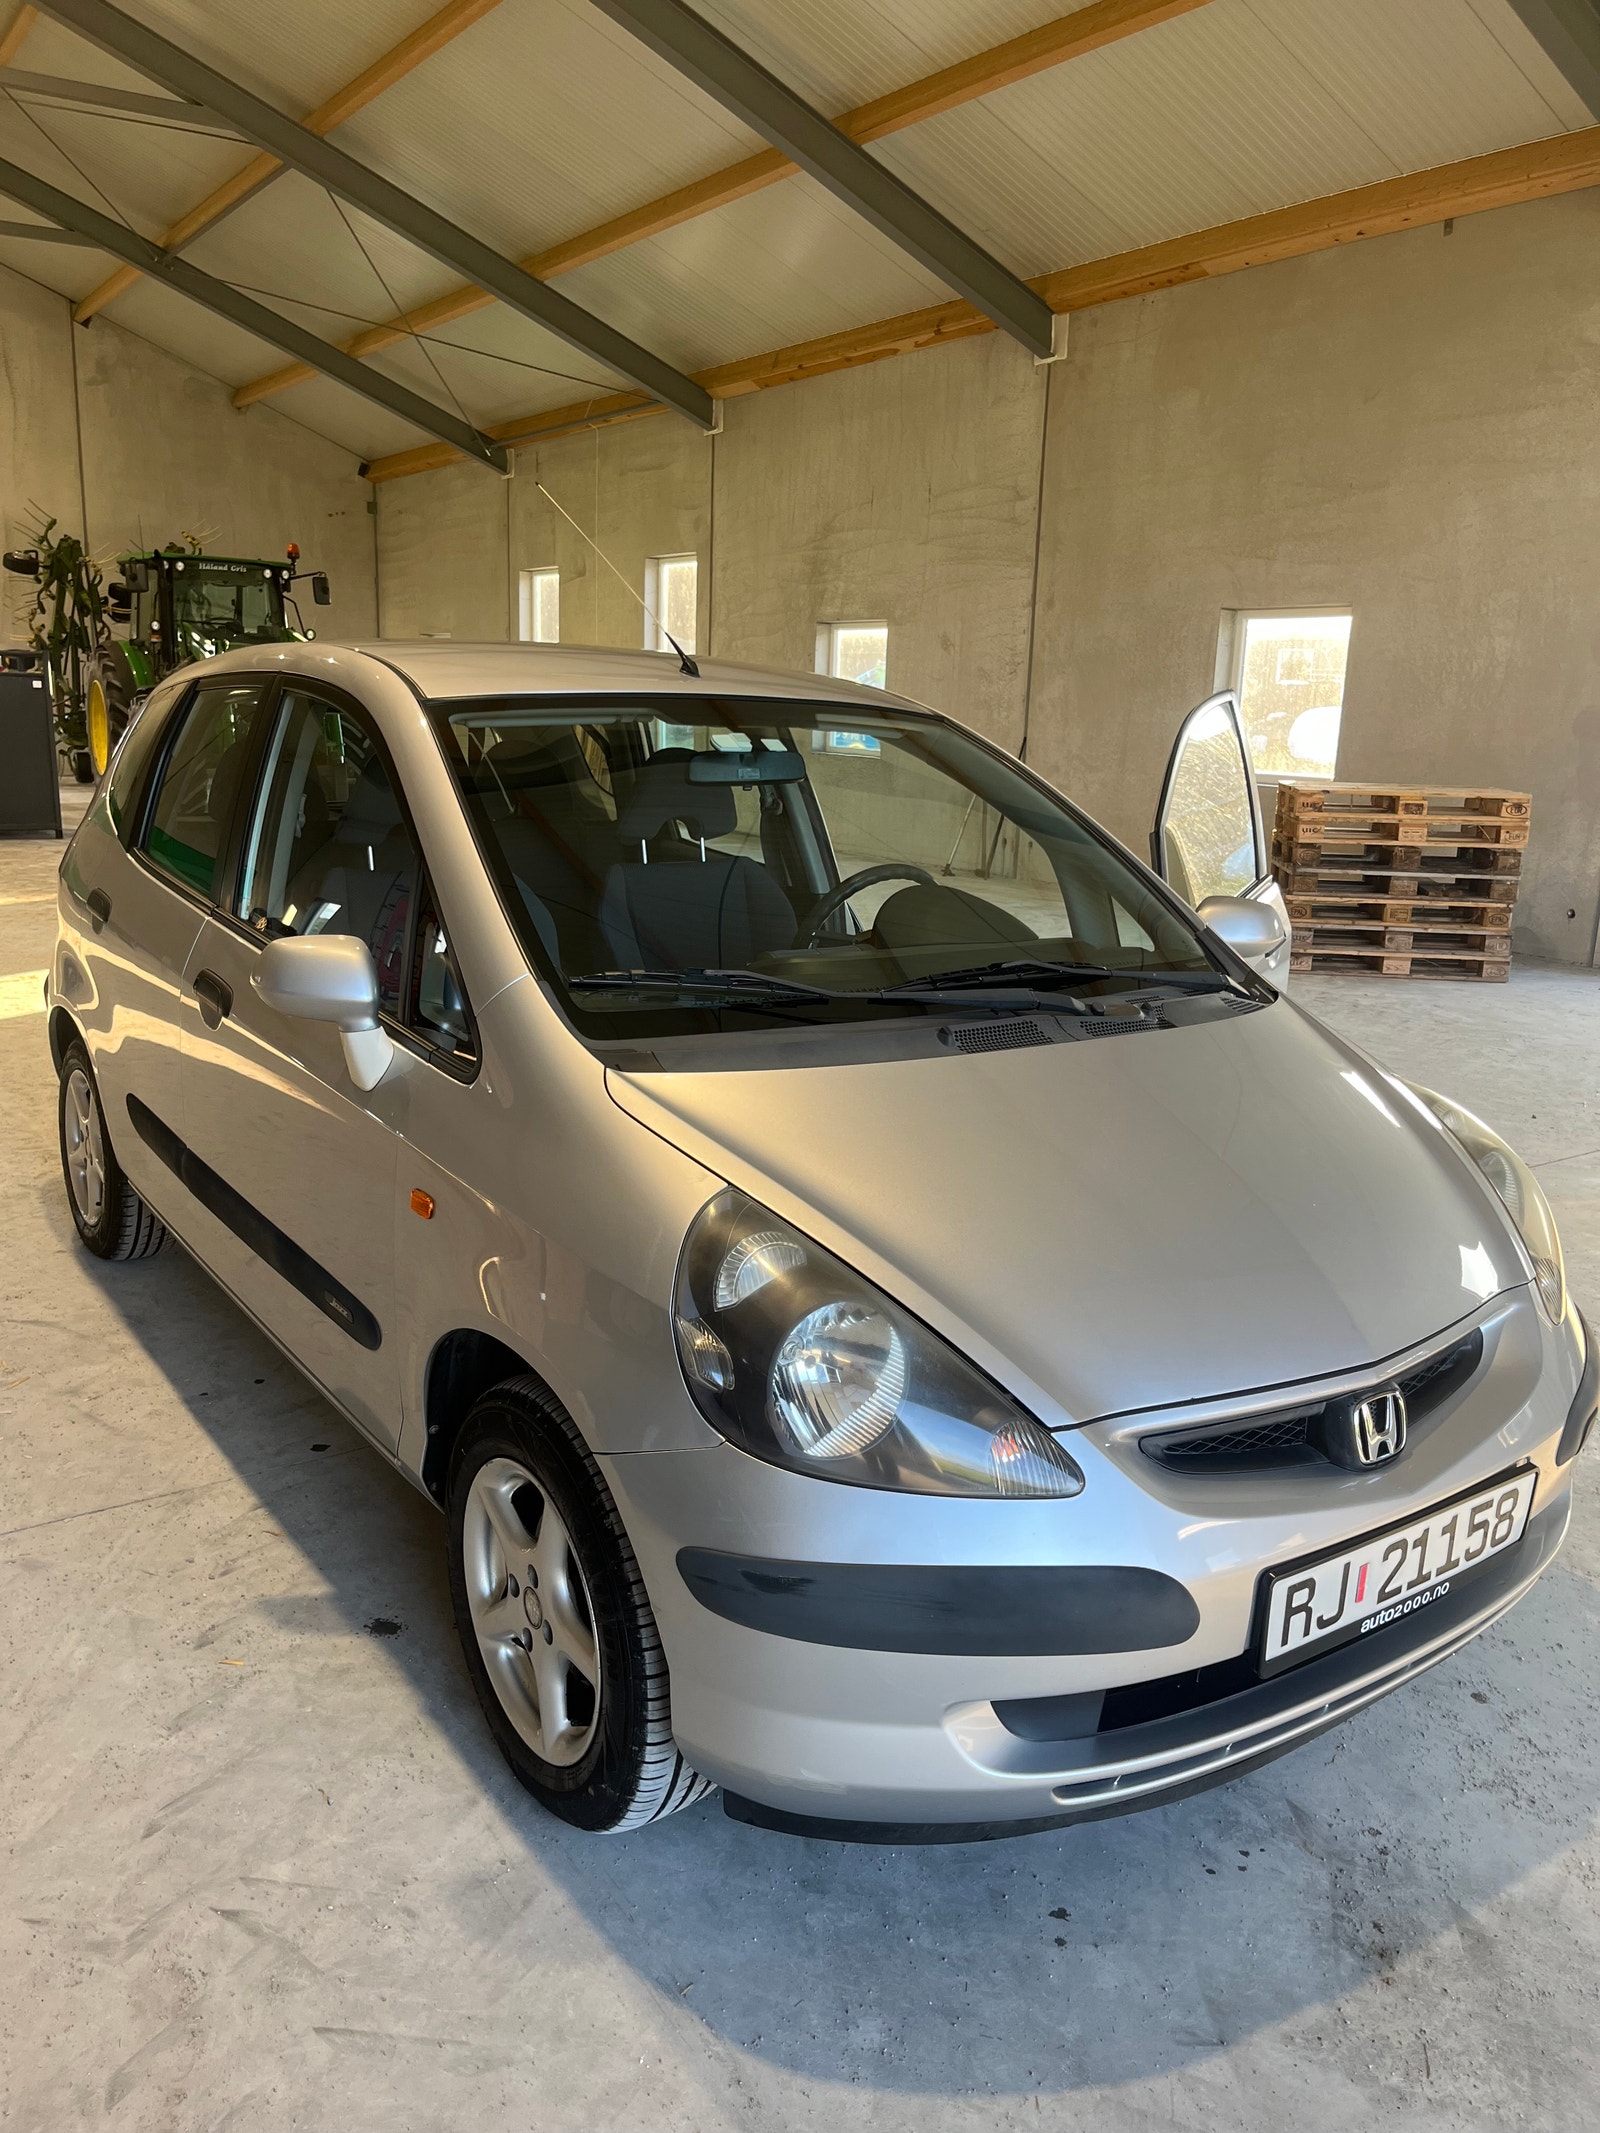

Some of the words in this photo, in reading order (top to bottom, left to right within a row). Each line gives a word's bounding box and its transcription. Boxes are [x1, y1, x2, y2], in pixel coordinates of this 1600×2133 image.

[1281, 1561, 1351, 1648] RJ
[1377, 1488, 1520, 1605] 21158
[1361, 1582, 1450, 1633] auto2000.no
